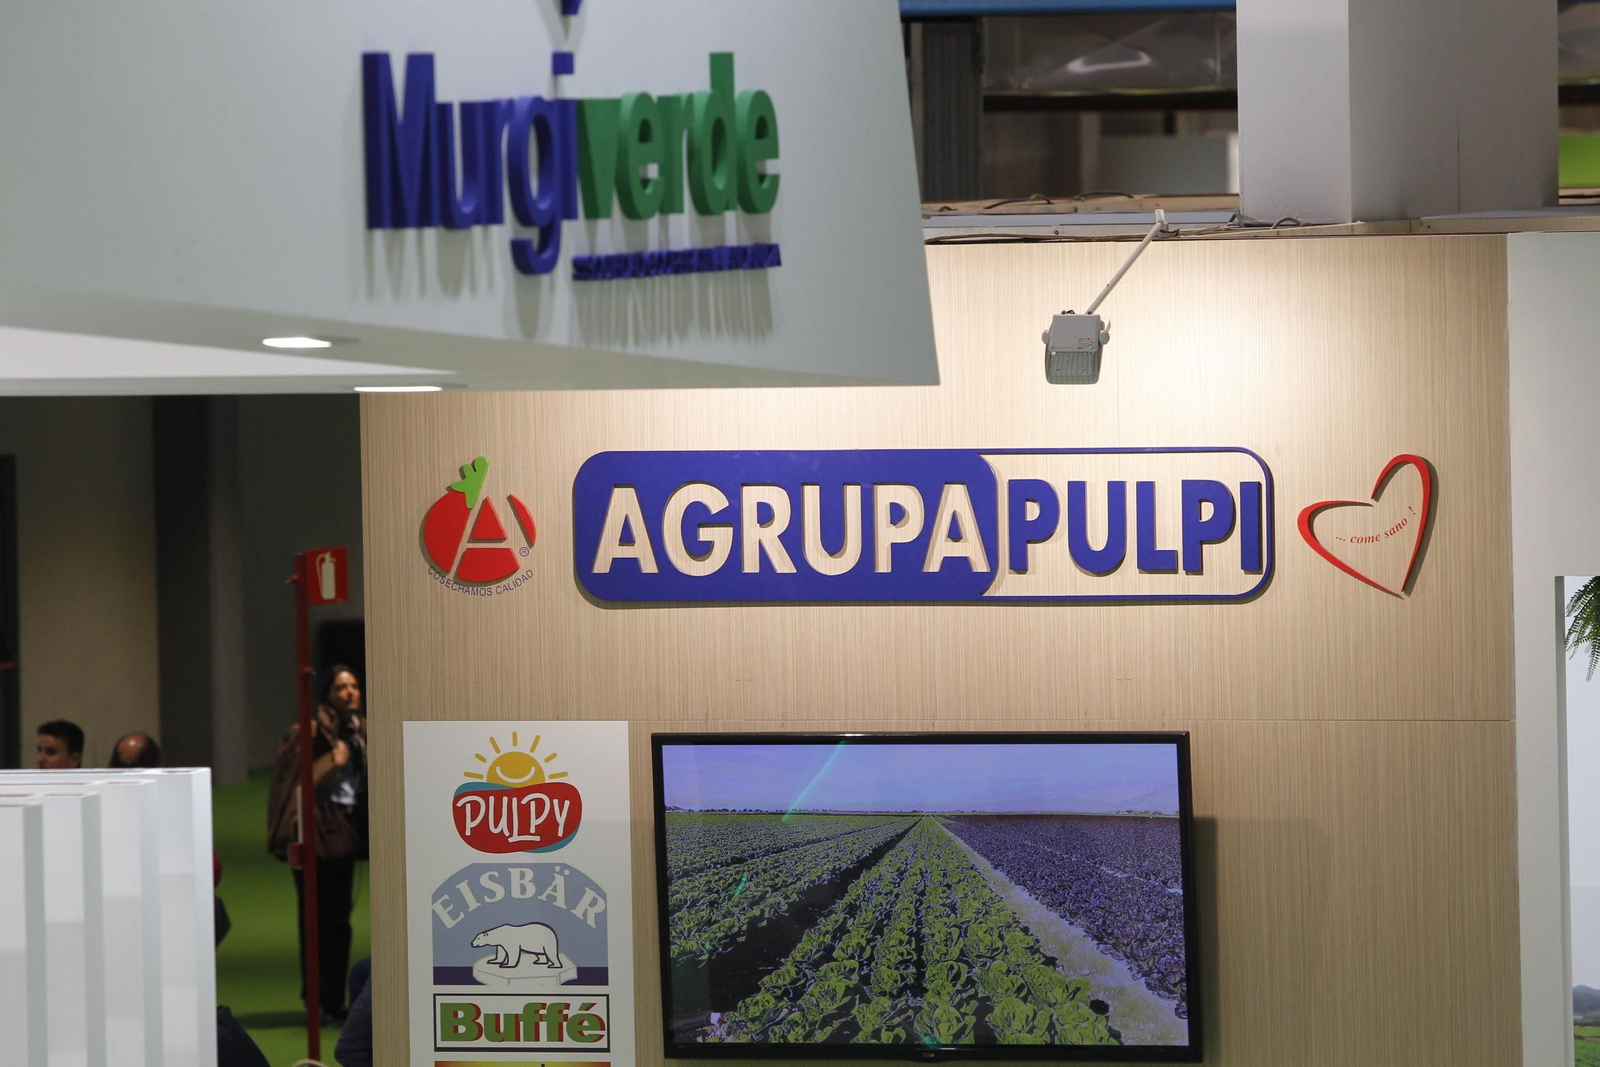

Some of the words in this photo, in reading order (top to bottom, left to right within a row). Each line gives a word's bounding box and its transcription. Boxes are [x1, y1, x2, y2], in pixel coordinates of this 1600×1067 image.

[362, 51, 781, 275] Murgiverde
[1350, 534, 1381, 545] come
[1384, 517, 1408, 539] sano
[427, 566, 493, 597] COSECHAMOS
[495, 569, 534, 595] CALIDAD
[456, 793, 571, 843] PULPY
[432, 866, 606, 929] EISBÄR
[441, 1002, 606, 1043] Buffé
